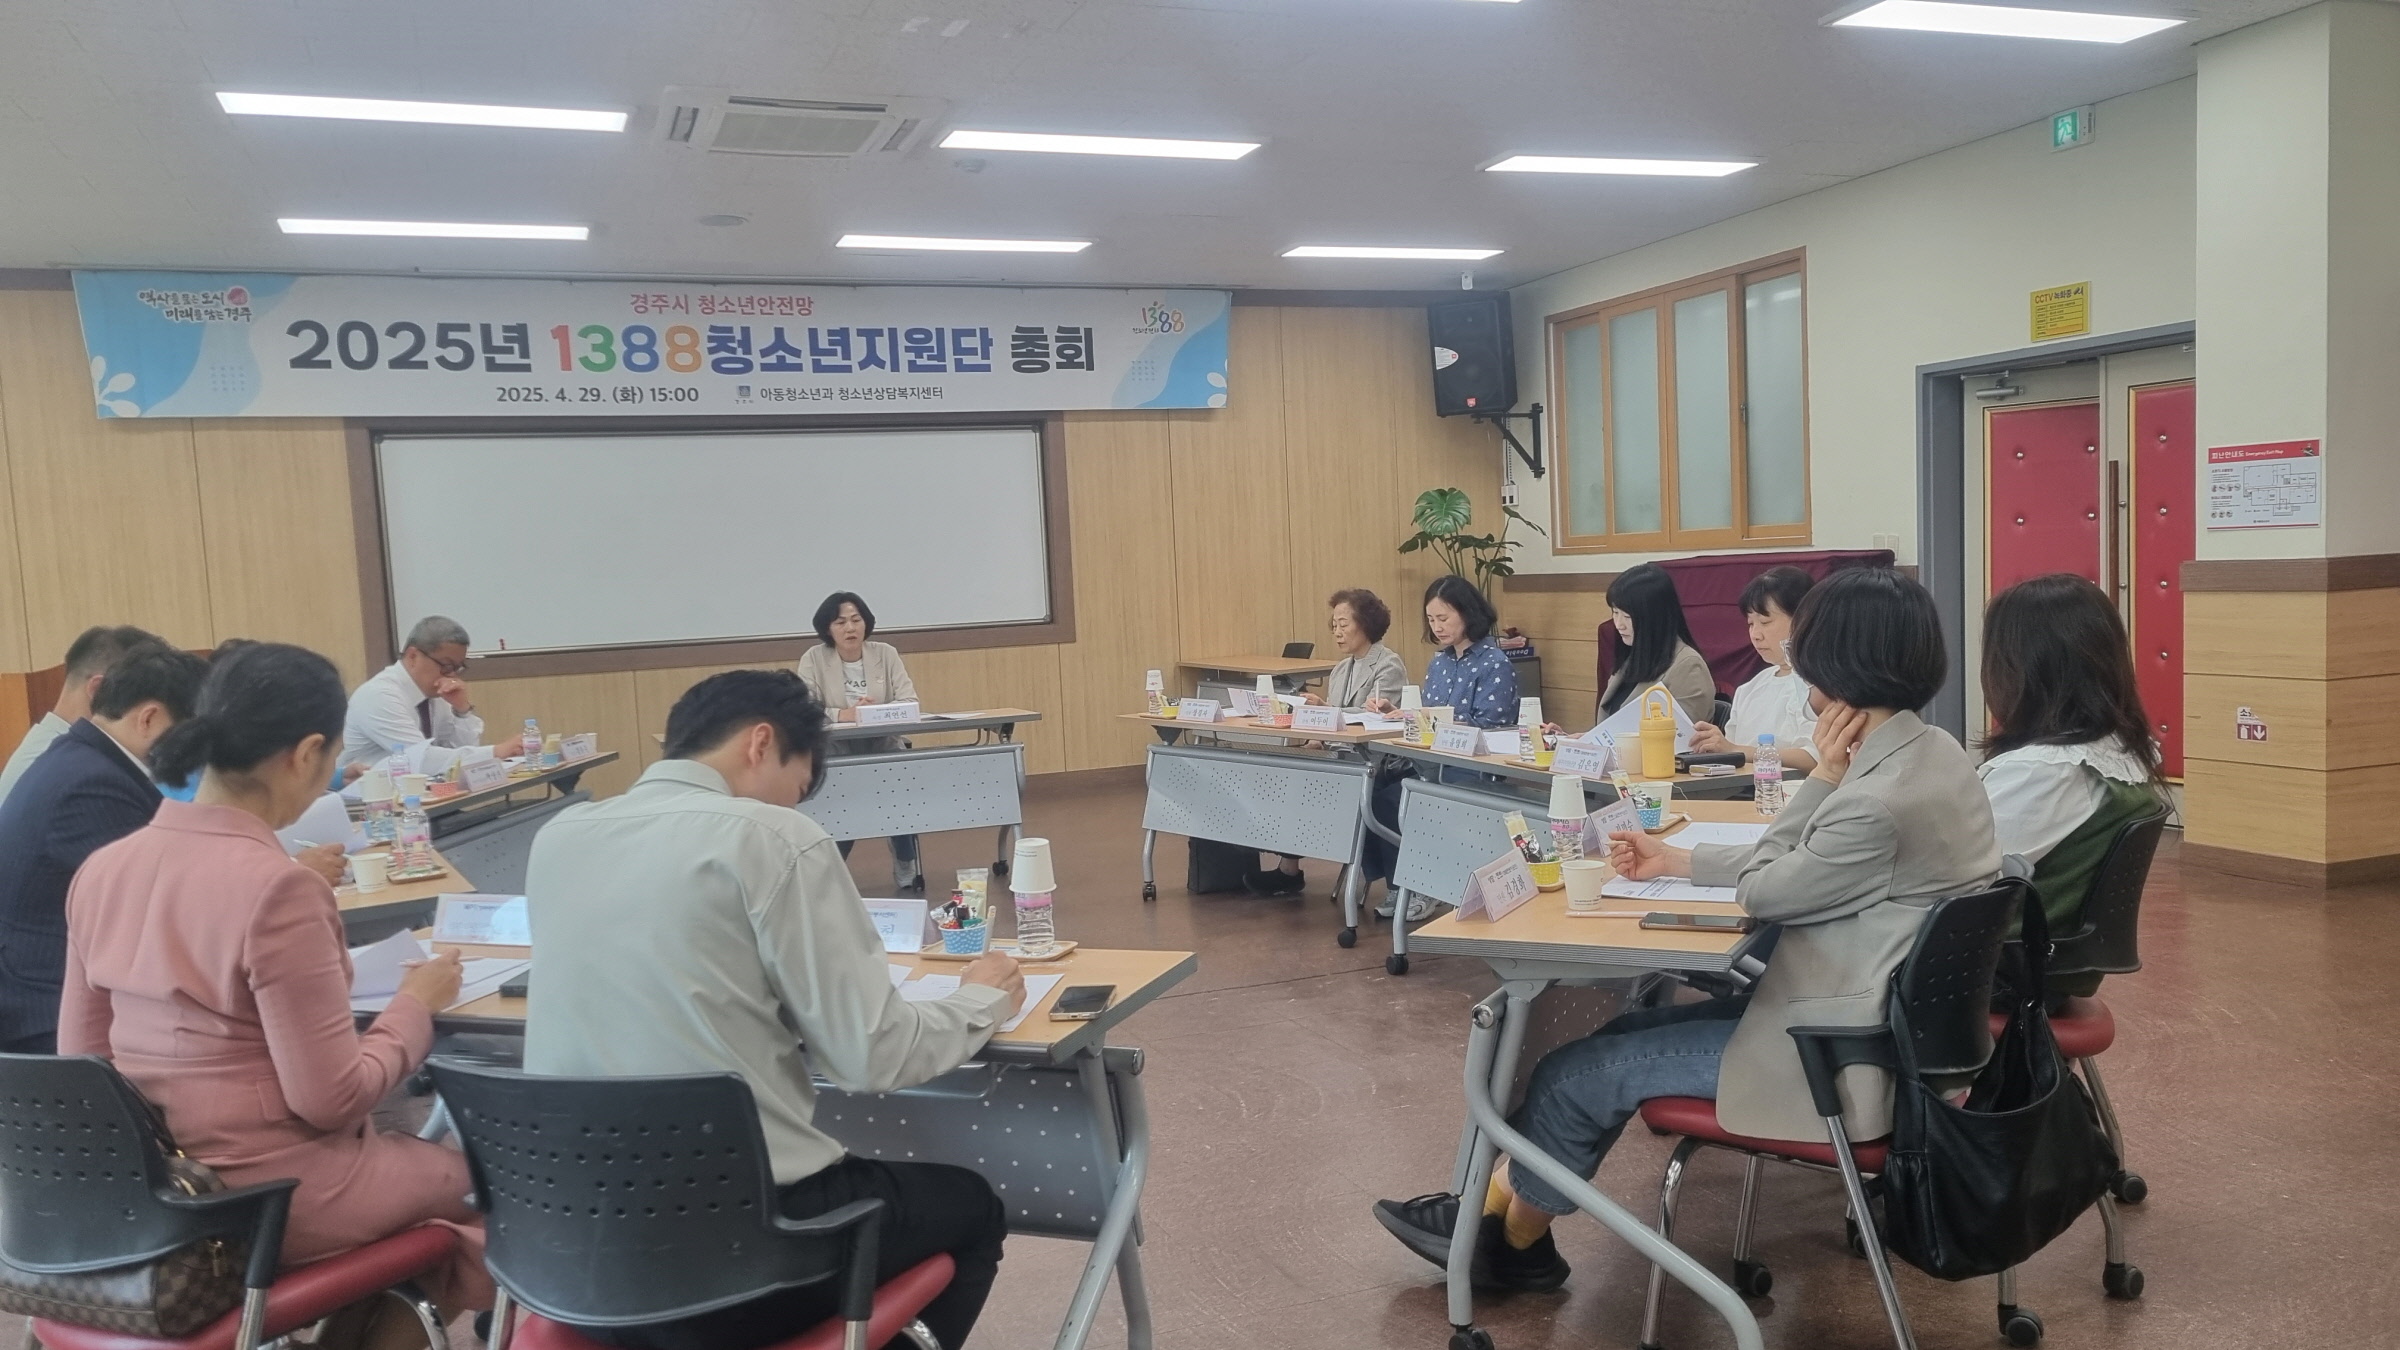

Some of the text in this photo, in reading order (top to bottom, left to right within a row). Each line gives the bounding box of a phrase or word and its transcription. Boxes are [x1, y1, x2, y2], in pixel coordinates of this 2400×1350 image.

[138, 289, 180, 306] 역사를
[201, 291, 225, 305] 도시
[630, 294, 815, 317] 경주시 청소년안전망
[2035, 293, 2053, 304] CCTV
[165, 307, 203, 321] 미래를
[224, 306, 252, 323] 경주
[1141, 302, 1185, 333] 1388
[285, 319, 532, 373] 2025년
[1010, 325, 1095, 374] 총회
[496, 386, 700, 404] 2025. 4. 29. (화) 15:00
[760, 386, 944, 402] 아동청소년과 청소년상담복지센터
[2211, 450, 2245, 460] 피난안내도
